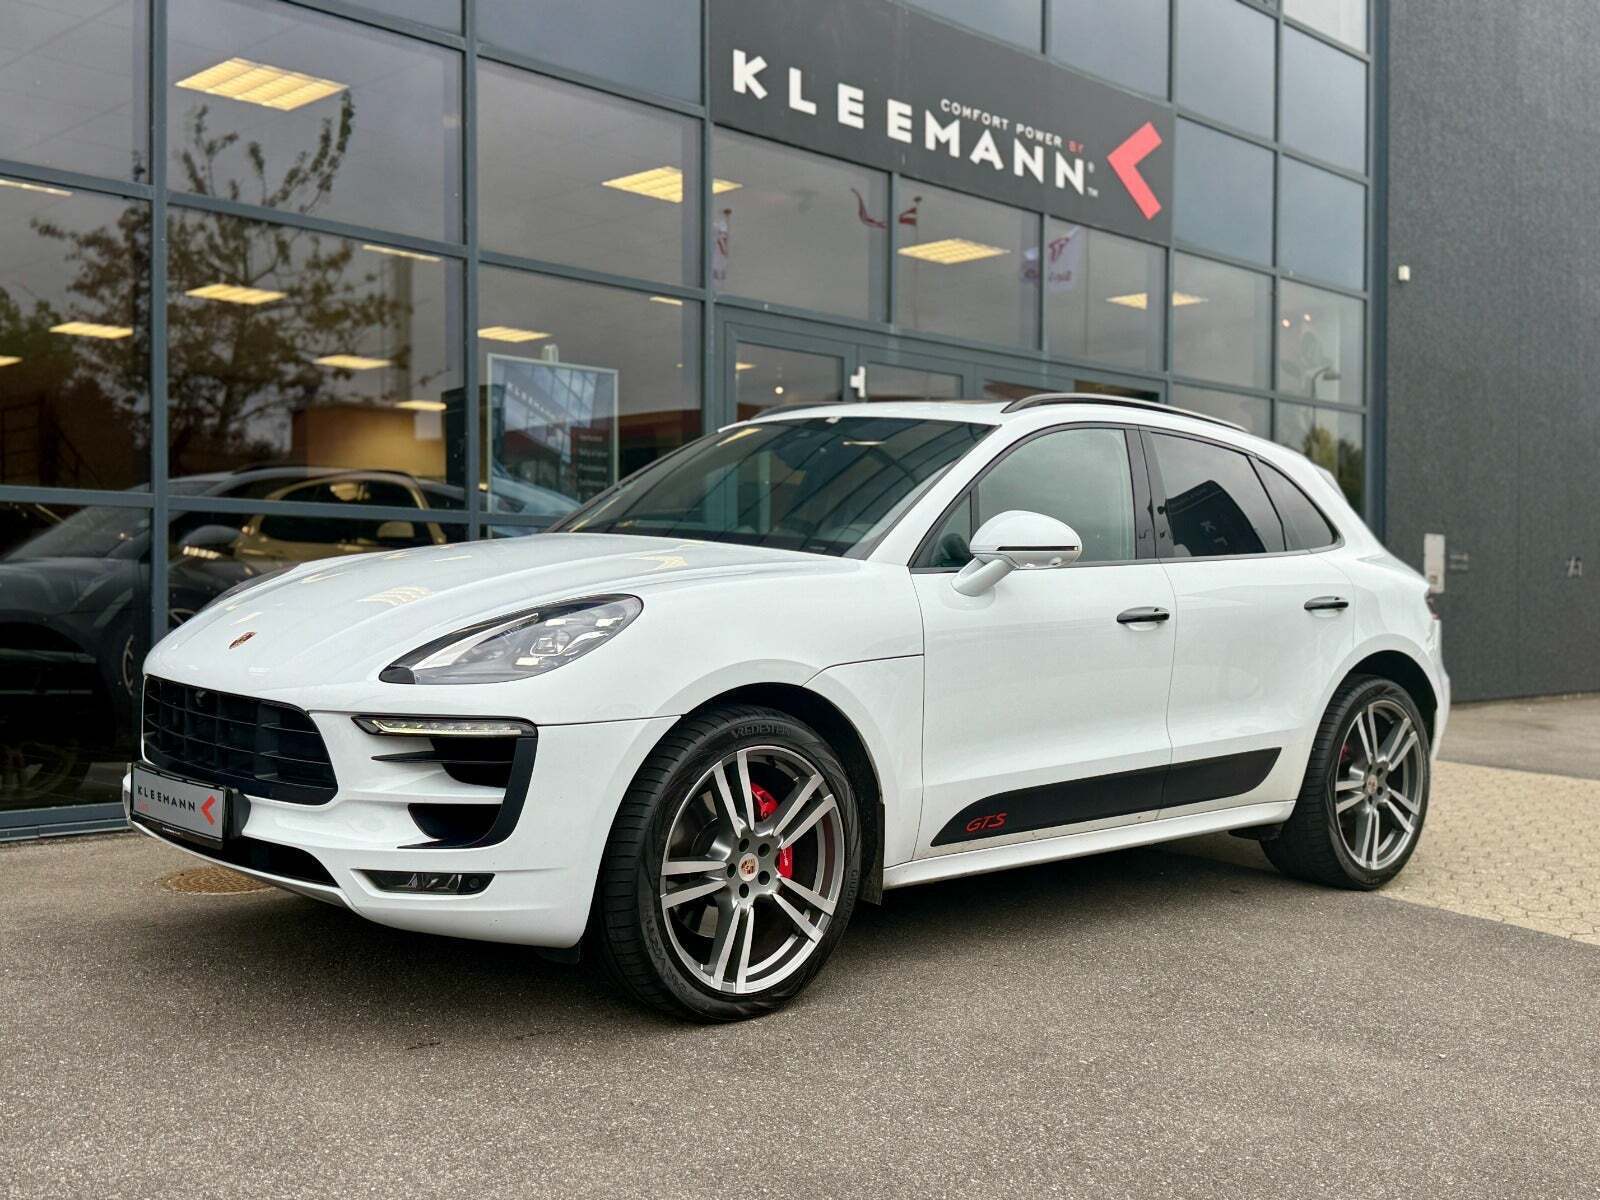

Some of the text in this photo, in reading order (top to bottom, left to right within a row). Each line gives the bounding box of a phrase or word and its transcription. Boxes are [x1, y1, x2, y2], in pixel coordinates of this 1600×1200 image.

[732, 48, 1085, 196] KLEEMANN
[940, 98, 1084, 154] COMFORT POWER BY
[137, 784, 196, 813] KLEEMANN
[965, 812, 1009, 833] GTS
